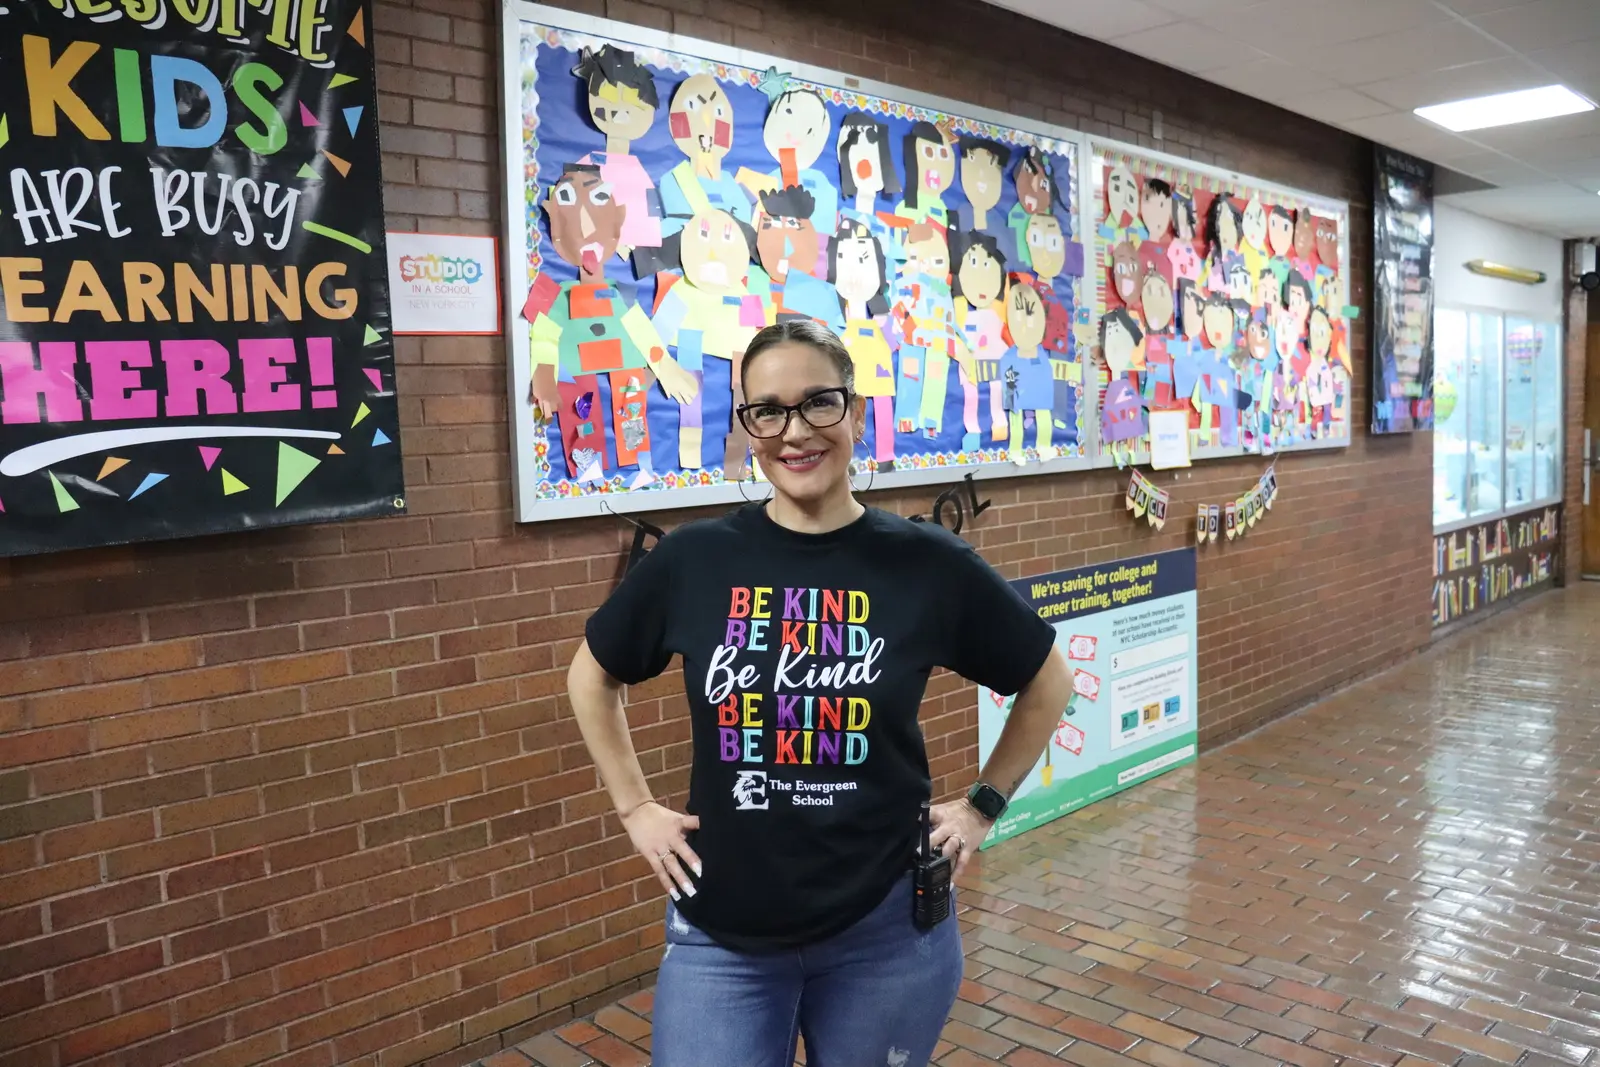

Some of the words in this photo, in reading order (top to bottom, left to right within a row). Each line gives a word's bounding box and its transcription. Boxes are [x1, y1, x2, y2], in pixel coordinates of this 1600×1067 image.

[22, 34, 290, 155] KIDS
[10, 166, 132, 246] ARE
[149, 167, 301, 251] BUSY
[403, 261, 478, 278] STUDIO
[0, 257, 359, 323] EARNING
[409, 299, 430, 310] NEW
[433, 300, 456, 310] YORK
[457, 300, 477, 310] CITY
[412, 285, 422, 294] IN
[425, 286, 432, 294] A
[435, 285, 473, 295] SCHOOL
[0, 337, 338, 425] HERE!
[1128, 480, 1166, 520] BACK
[1198, 515, 1219, 532] TO
[1227, 476, 1277, 530] SCHOOL
[1031, 580, 1060, 600] We're
[1062, 574, 1093, 594] saving
[1094, 571, 1107, 586] for
[1109, 566, 1140, 583] college
[1141, 560, 1157, 576] and
[1037, 602, 1070, 618] career
[1071, 592, 1112, 609] training,
[1112, 580, 1153, 604] together!
[727, 587, 773, 618] BE
[782, 587, 870, 624] KIND
[725, 619, 770, 652] BE
[779, 620, 870, 656] KIND
[705, 644, 761, 704] Be
[774, 637, 885, 693] Kind
[717, 692, 764, 727] BE
[776, 694, 872, 731] KIND
[719, 727, 764, 762] BE
[774, 730, 869, 765] KIND
[769, 779, 792, 791] The
[796, 779, 858, 792] Evergreen
[792, 794, 834, 806] School
